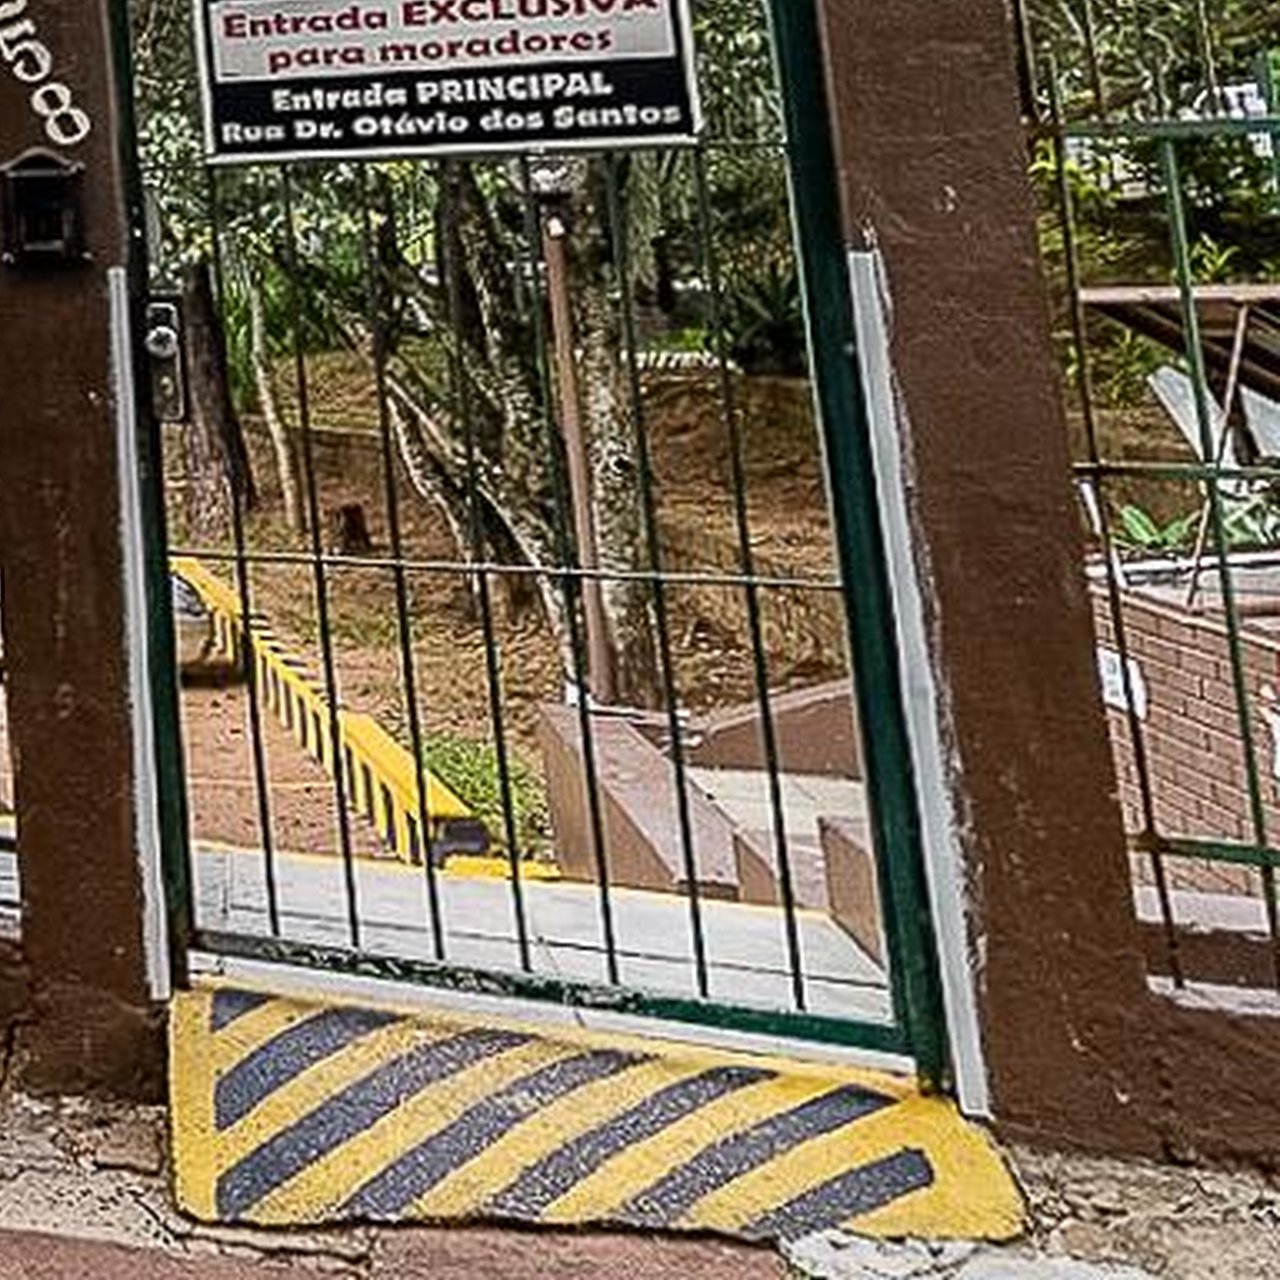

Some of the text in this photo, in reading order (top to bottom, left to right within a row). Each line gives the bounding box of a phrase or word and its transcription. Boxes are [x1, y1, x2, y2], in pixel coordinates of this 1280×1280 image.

[222, 5, 388, 39] Entrada
[267, 28, 613, 74] para moradores
[271, 72, 615, 112] Entrada PRINCIPAL
[221, 104, 682, 144] Rua Dr. Otávio dos Santos
